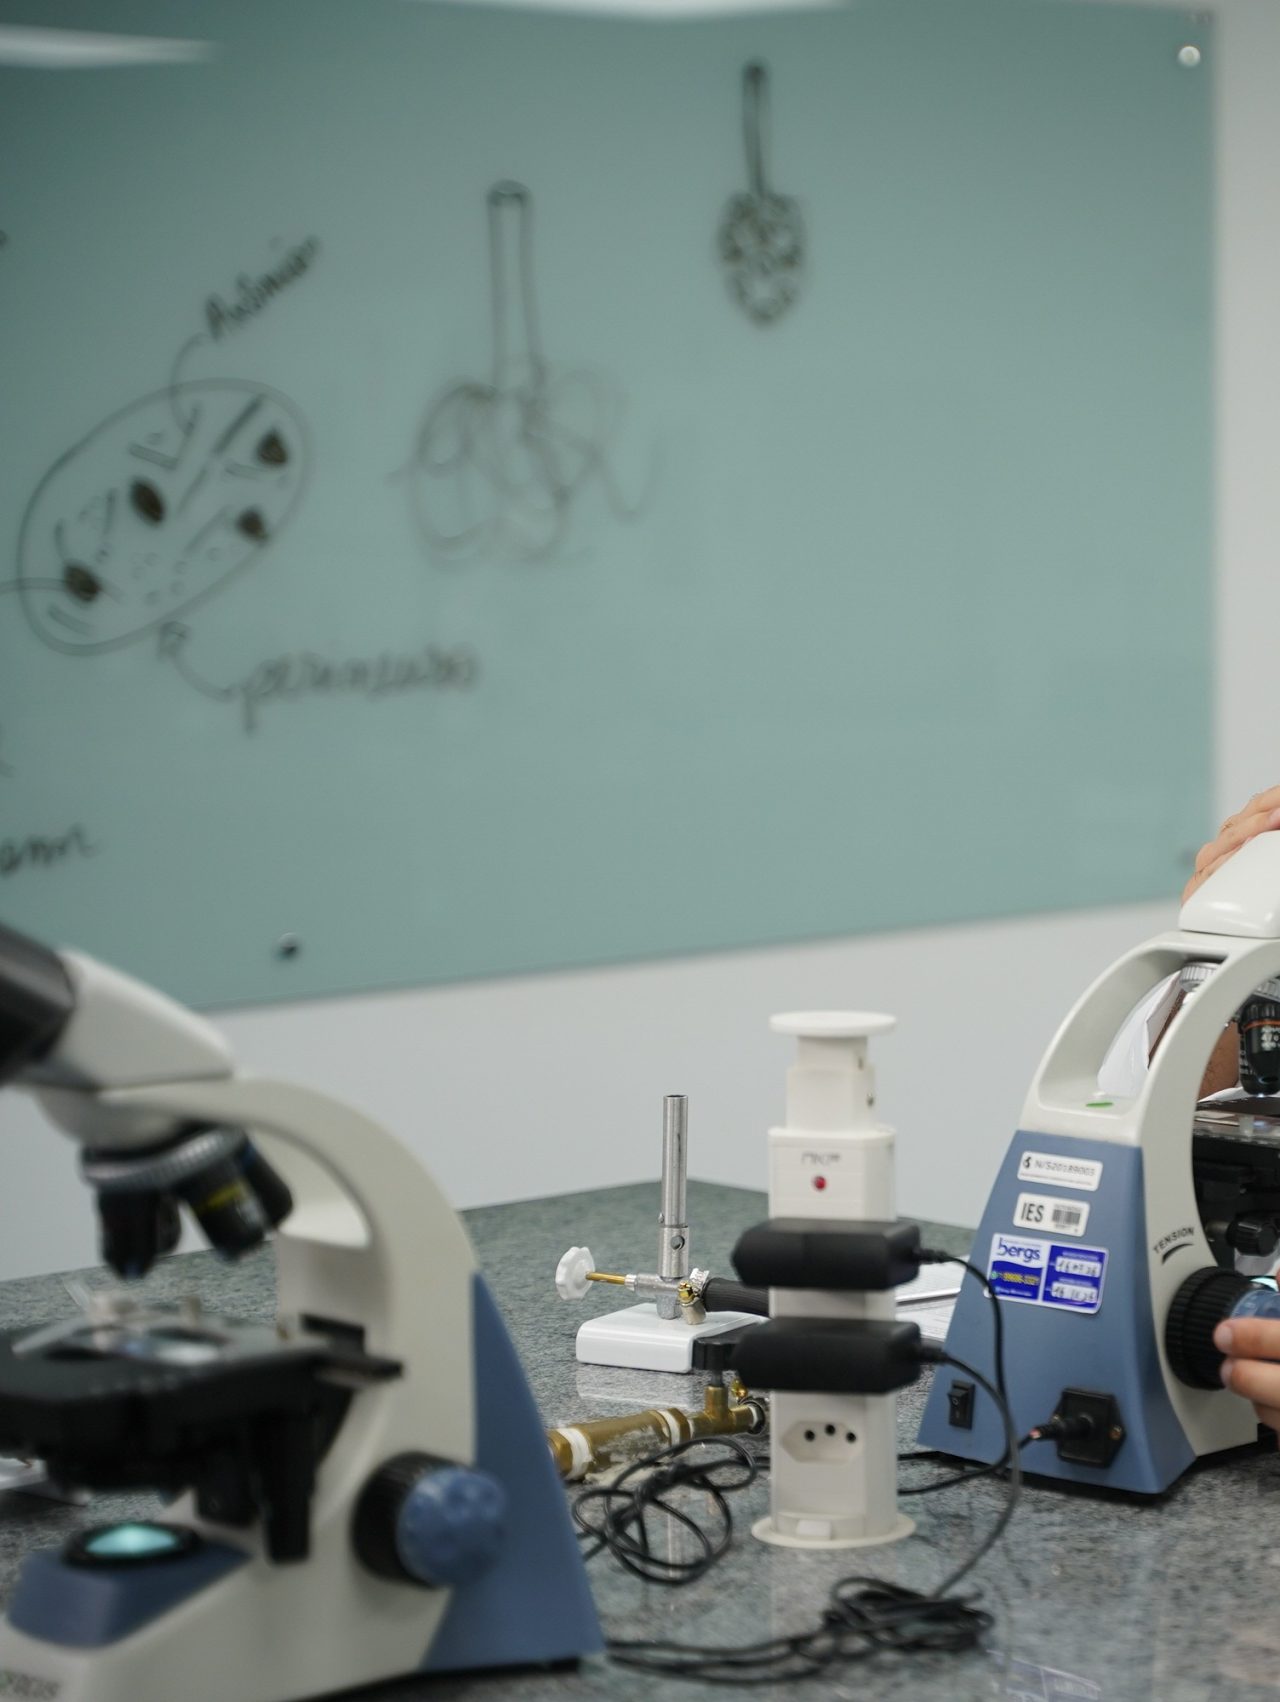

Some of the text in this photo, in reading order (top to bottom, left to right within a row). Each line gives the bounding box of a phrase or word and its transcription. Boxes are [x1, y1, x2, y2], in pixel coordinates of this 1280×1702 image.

[1020, 1202, 1045, 1223] IES
[998, 1237, 1041, 1263] bergs
[1153, 1226, 1195, 1253] TENSION
